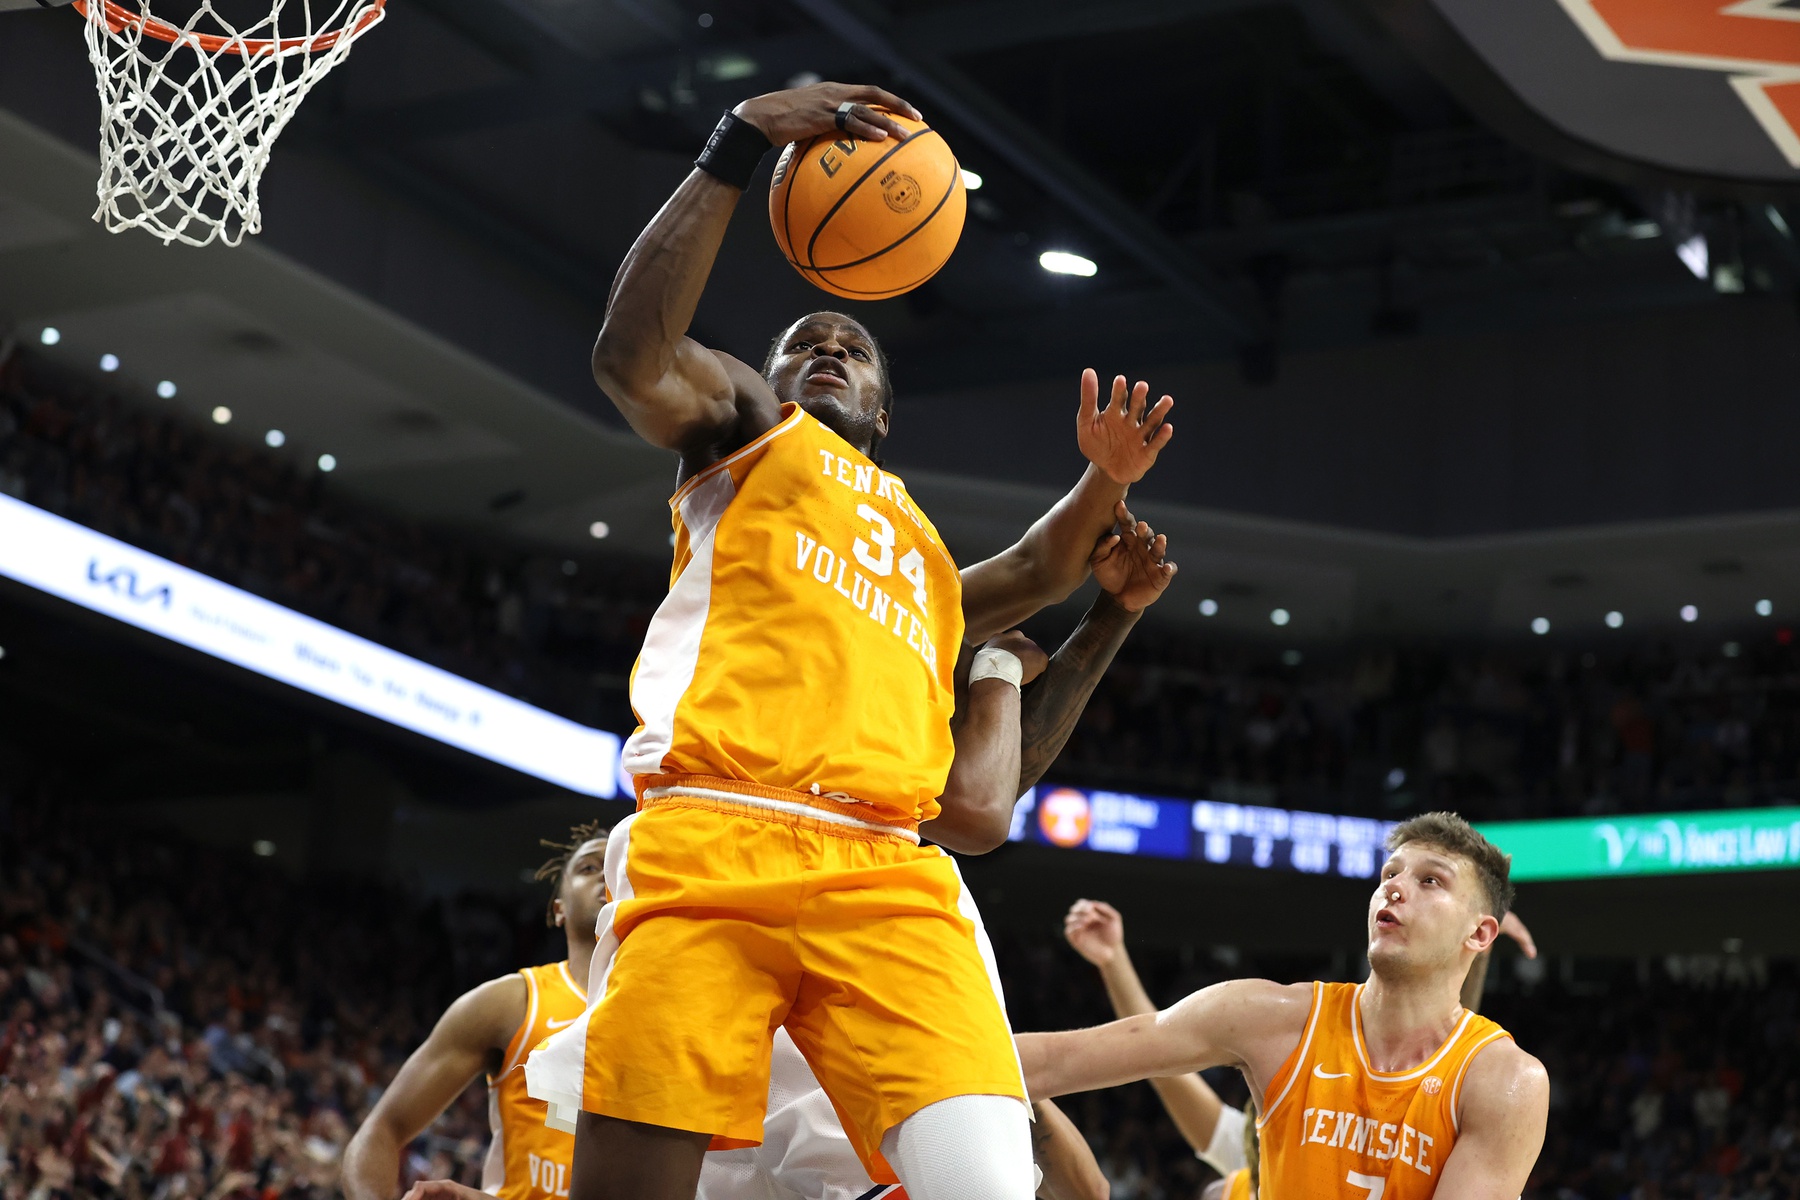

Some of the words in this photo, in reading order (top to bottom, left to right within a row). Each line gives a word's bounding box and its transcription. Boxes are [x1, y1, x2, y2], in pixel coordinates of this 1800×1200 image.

[818, 133, 866, 178] EV
[852, 504, 928, 618] 34
[1422, 1077, 1442, 1095] SEC
[528, 1152, 570, 1197] VOL
